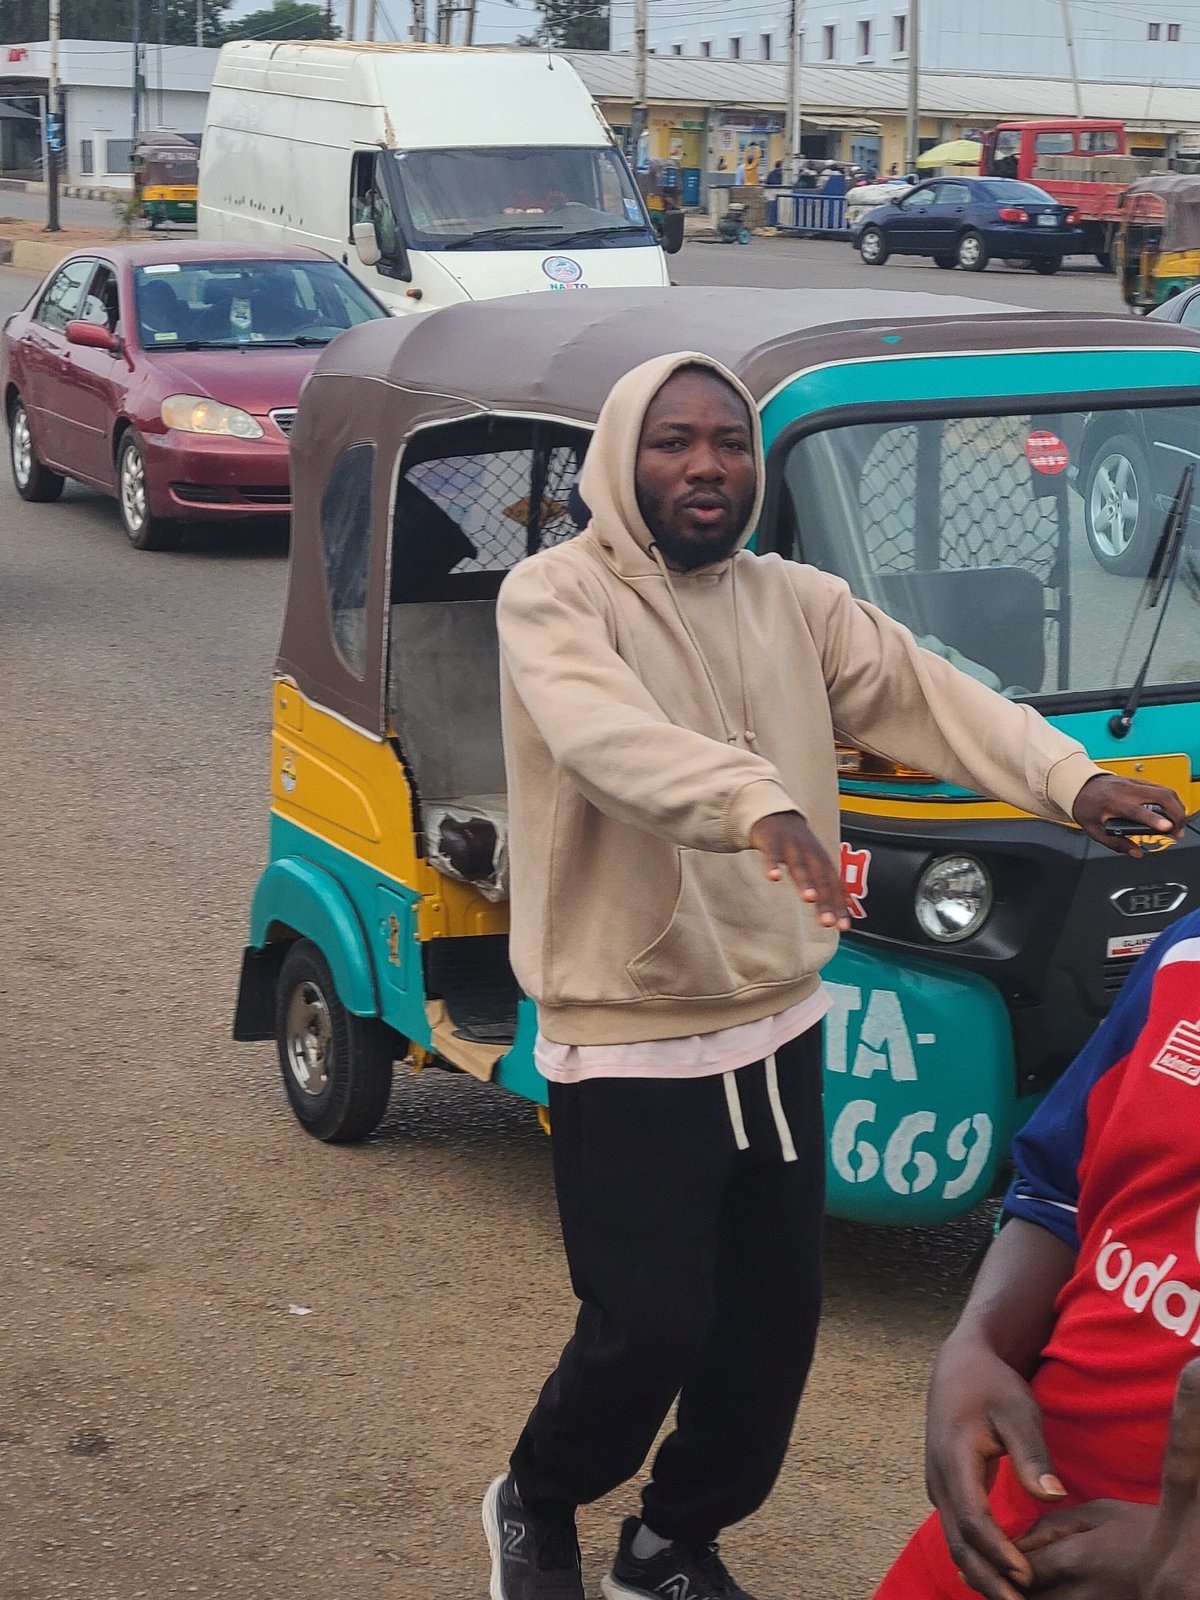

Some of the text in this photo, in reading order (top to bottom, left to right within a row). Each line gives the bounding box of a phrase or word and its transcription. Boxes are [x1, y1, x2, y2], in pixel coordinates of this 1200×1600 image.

[1129, 892, 1170, 911] RE
[831, 1100, 993, 1200] 669
[1096, 1228, 1200, 1347] oda
